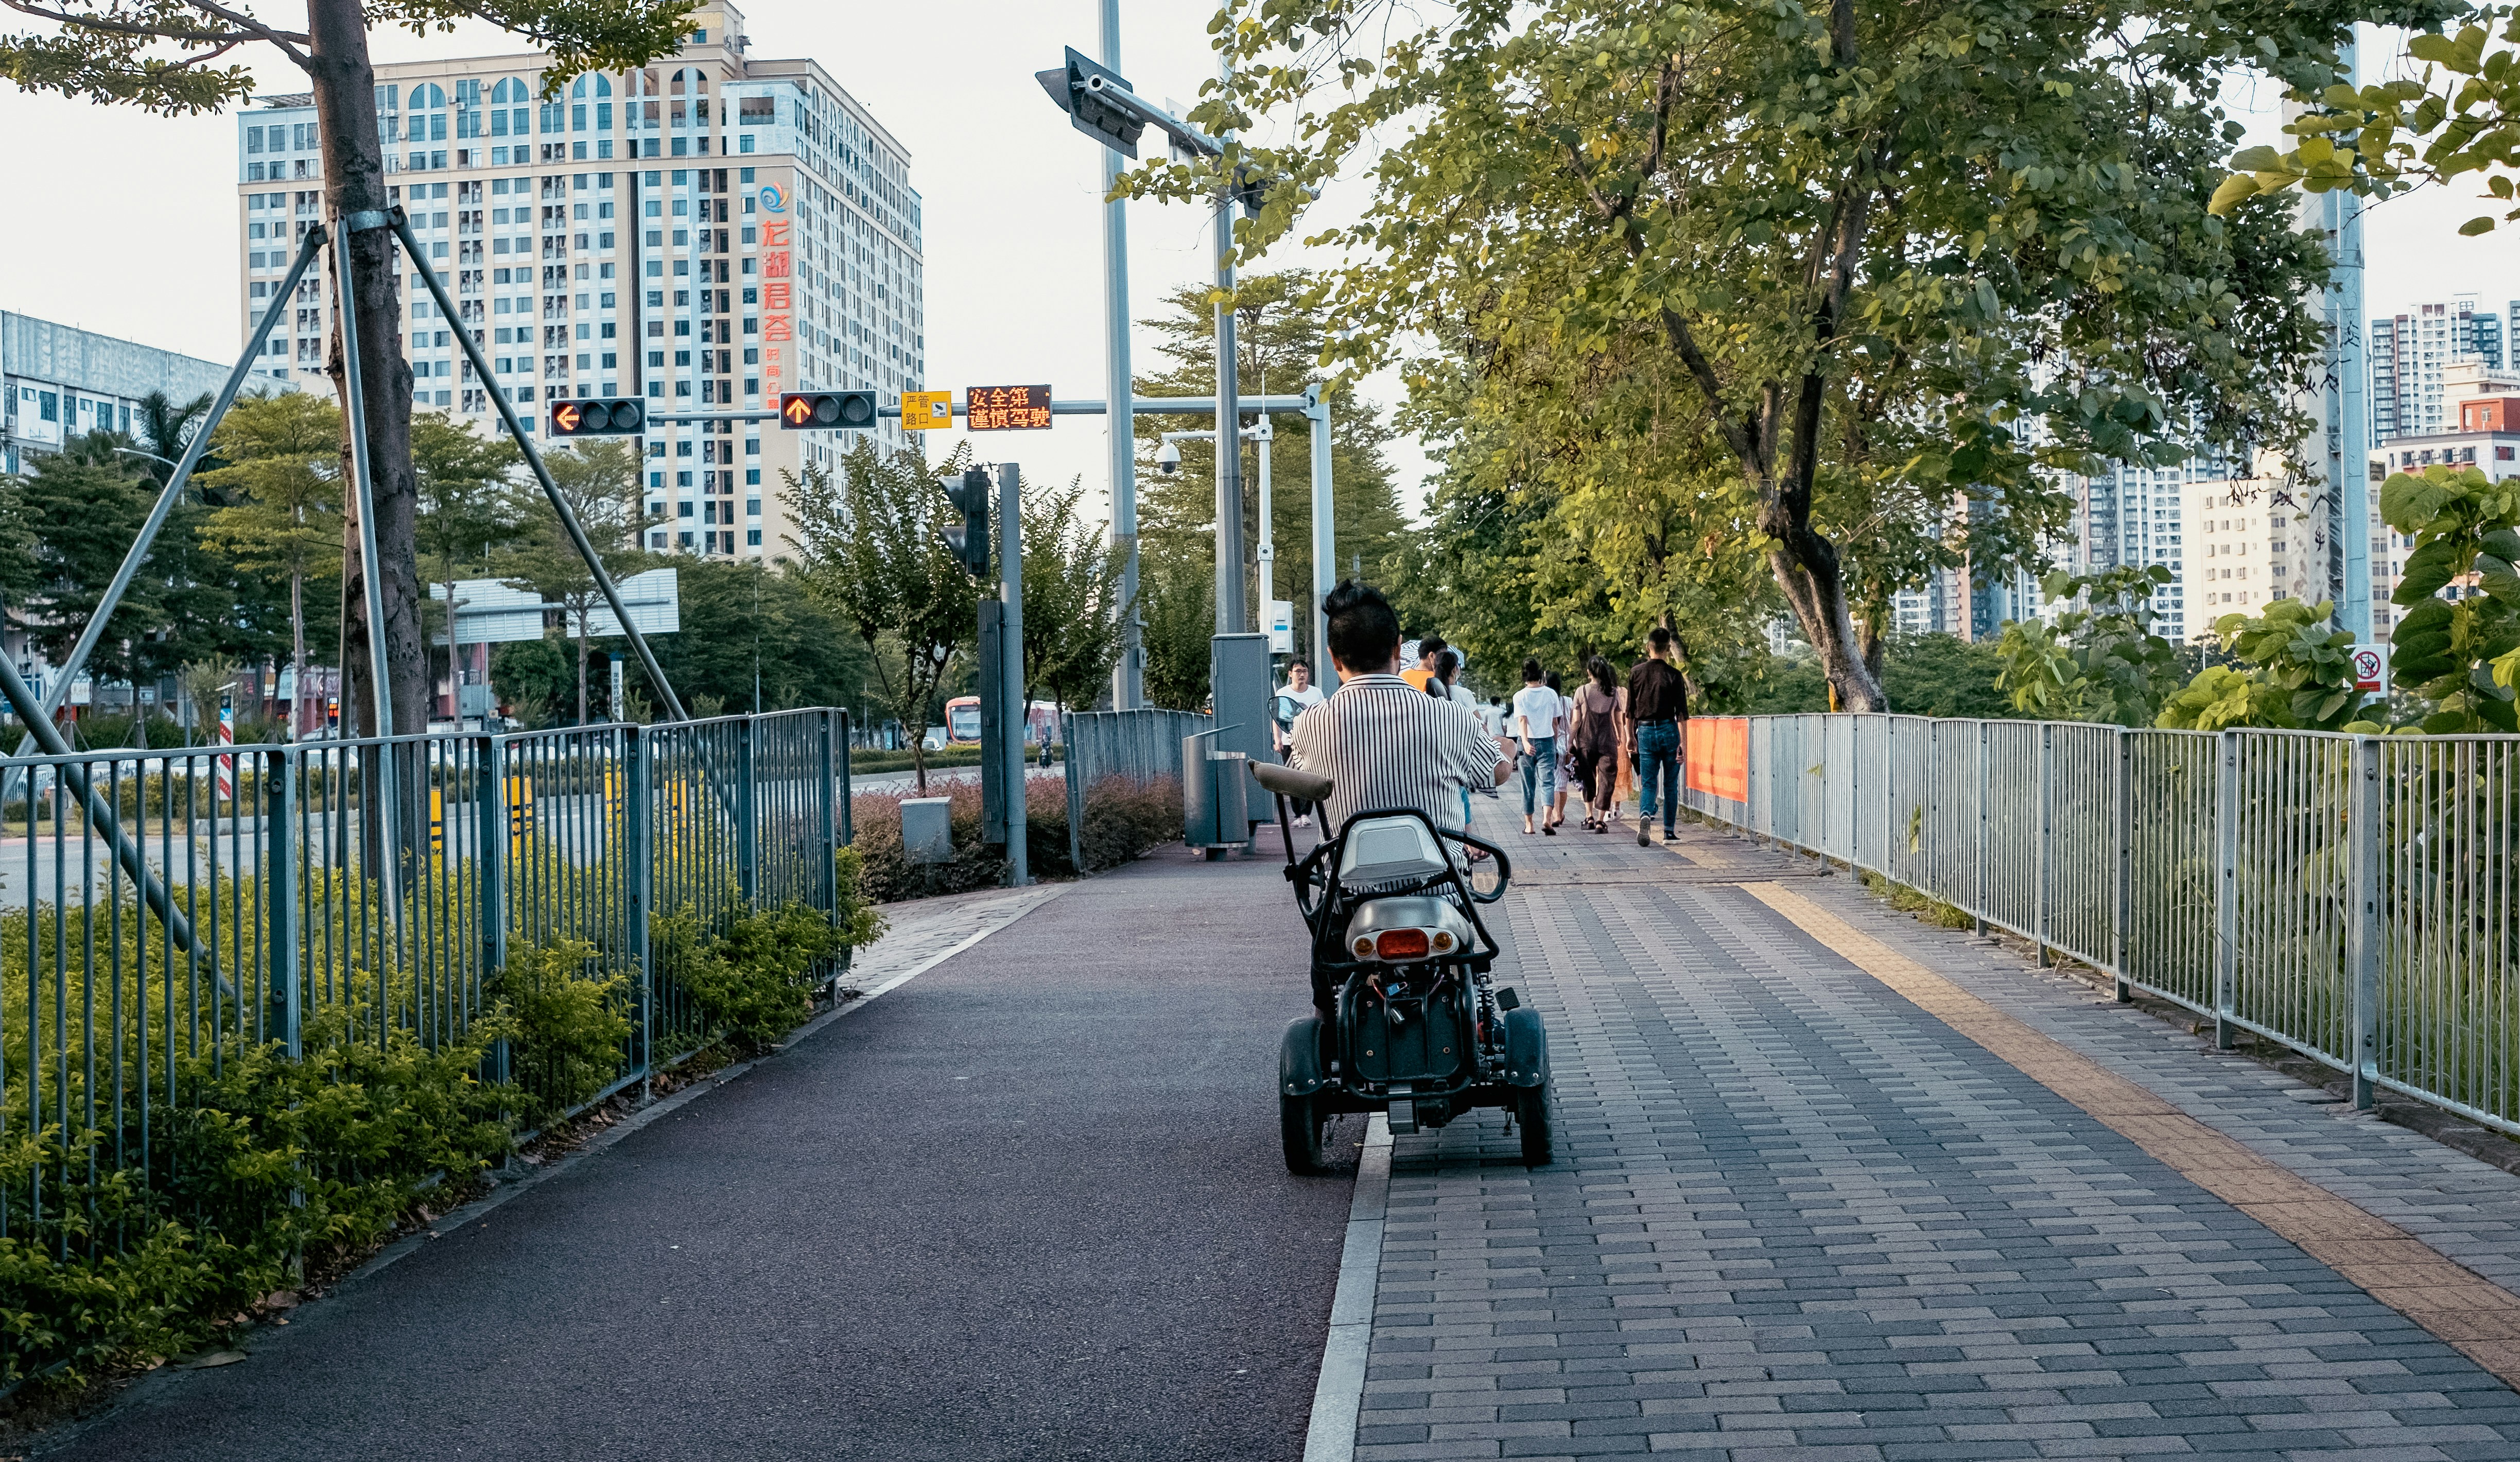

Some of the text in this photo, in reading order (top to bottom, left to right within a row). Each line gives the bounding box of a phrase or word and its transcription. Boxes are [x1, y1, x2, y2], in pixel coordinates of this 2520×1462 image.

[762, 219, 791, 341] 龙湖君荟
[906, 395, 929, 408] 严管
[969, 387, 1050, 408] 安全第
[906, 412, 928, 425] 路口
[968, 406, 1050, 428] 谨慎驾驶
